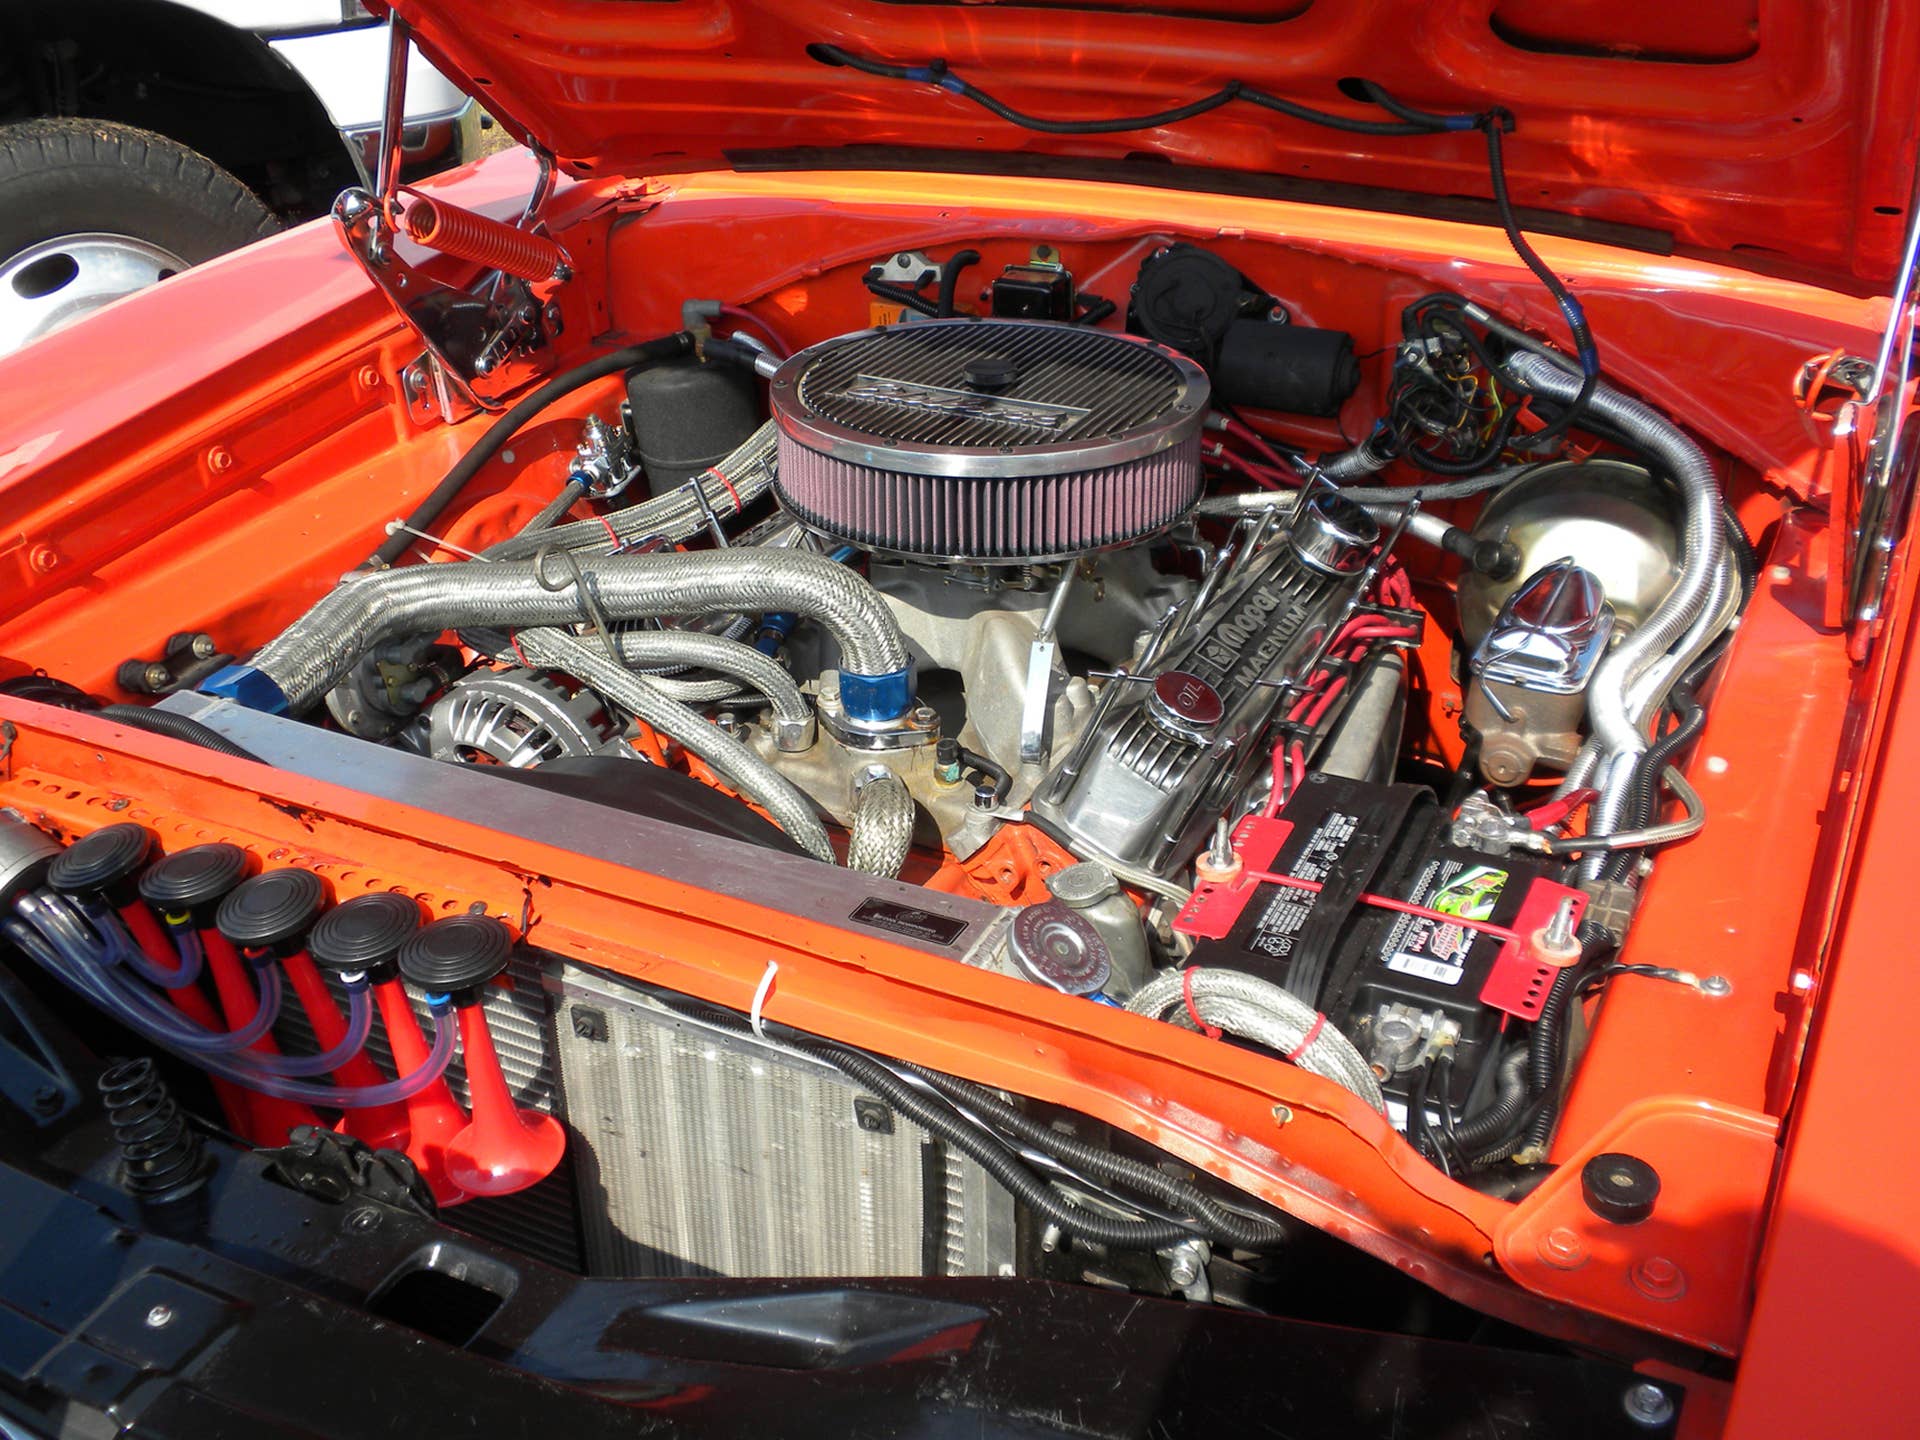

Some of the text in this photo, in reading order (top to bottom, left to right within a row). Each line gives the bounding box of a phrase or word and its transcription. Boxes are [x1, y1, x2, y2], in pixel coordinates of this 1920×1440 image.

[1216, 586, 1280, 649] Mopar
[1235, 603, 1308, 688] MAGNUM
[1177, 680, 1205, 709] OIL
